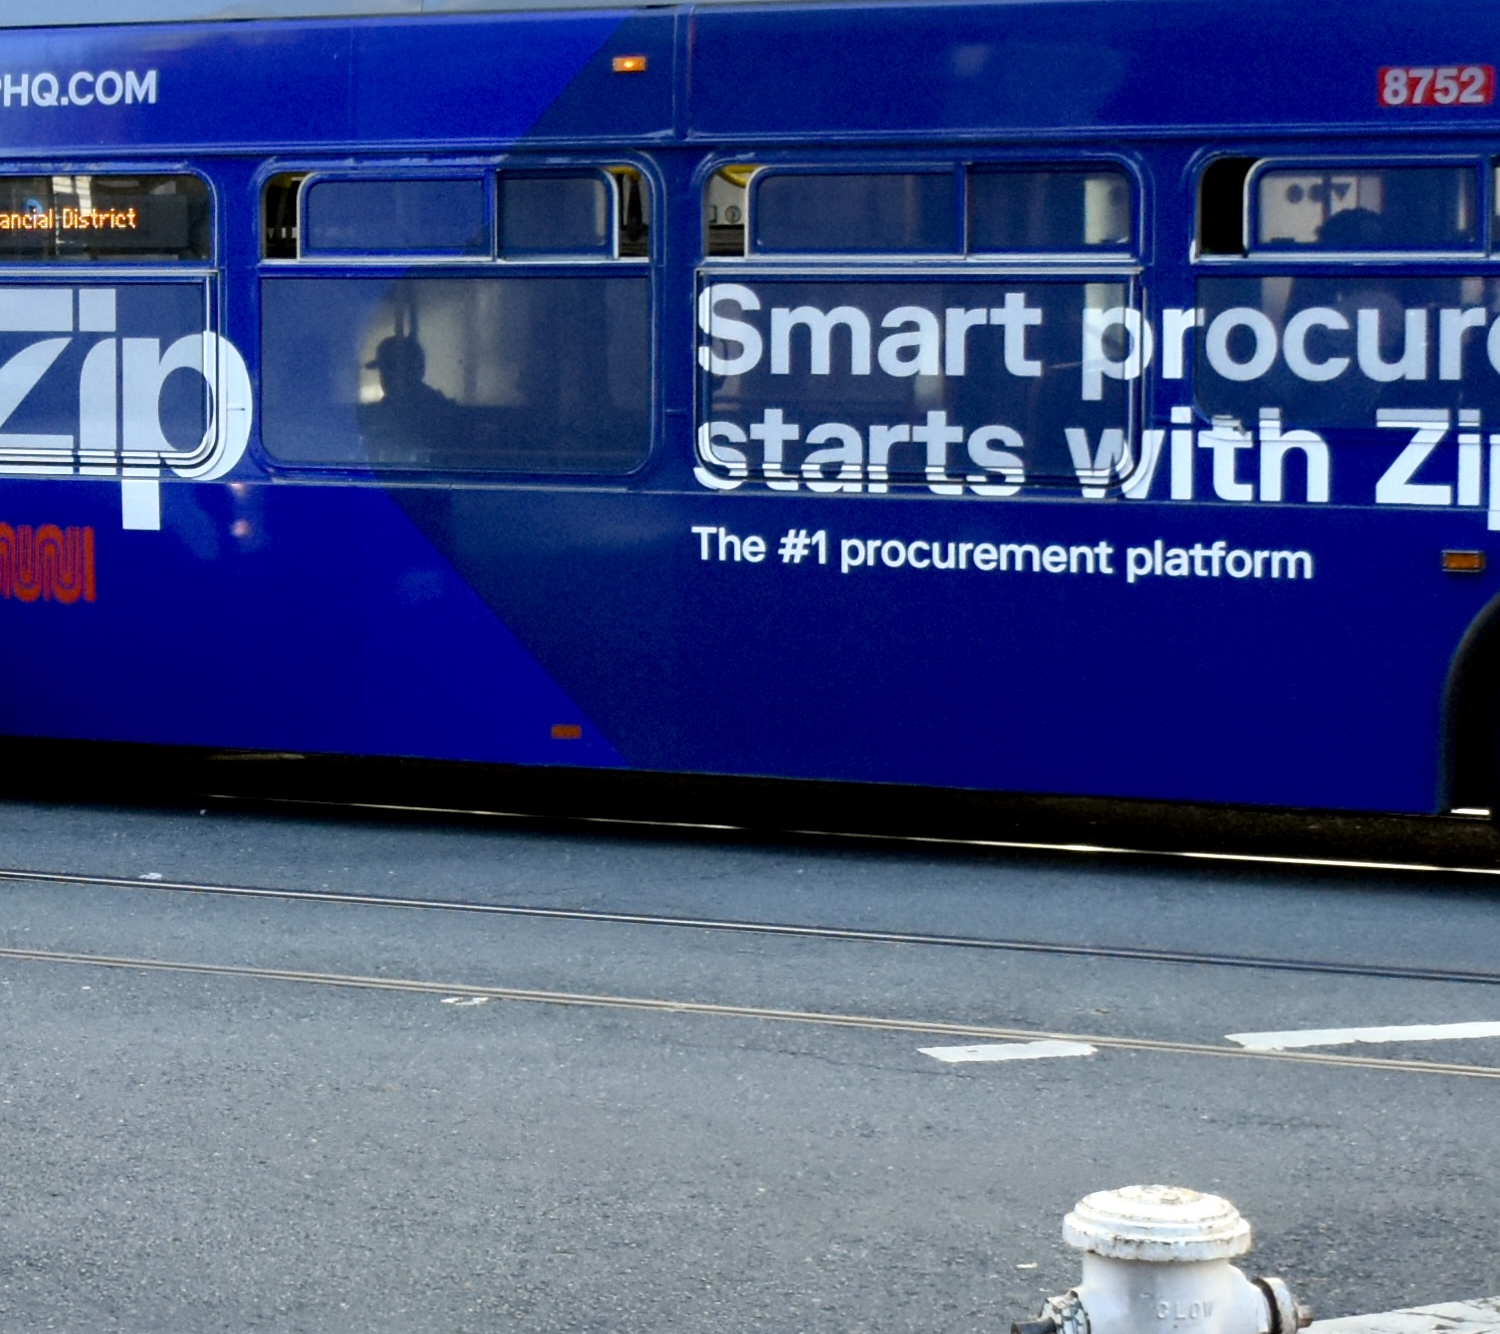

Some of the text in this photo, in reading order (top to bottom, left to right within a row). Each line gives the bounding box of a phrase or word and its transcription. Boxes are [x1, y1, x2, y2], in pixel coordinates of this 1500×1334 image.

[1382, 67, 1486, 105] 8752
[61, 208, 137, 230] District
[697, 282, 1042, 378] Smart
[693, 408, 1025, 497] starts
[1064, 406, 1330, 501] with
[691, 526, 1313, 583] The #1 procurement platform
